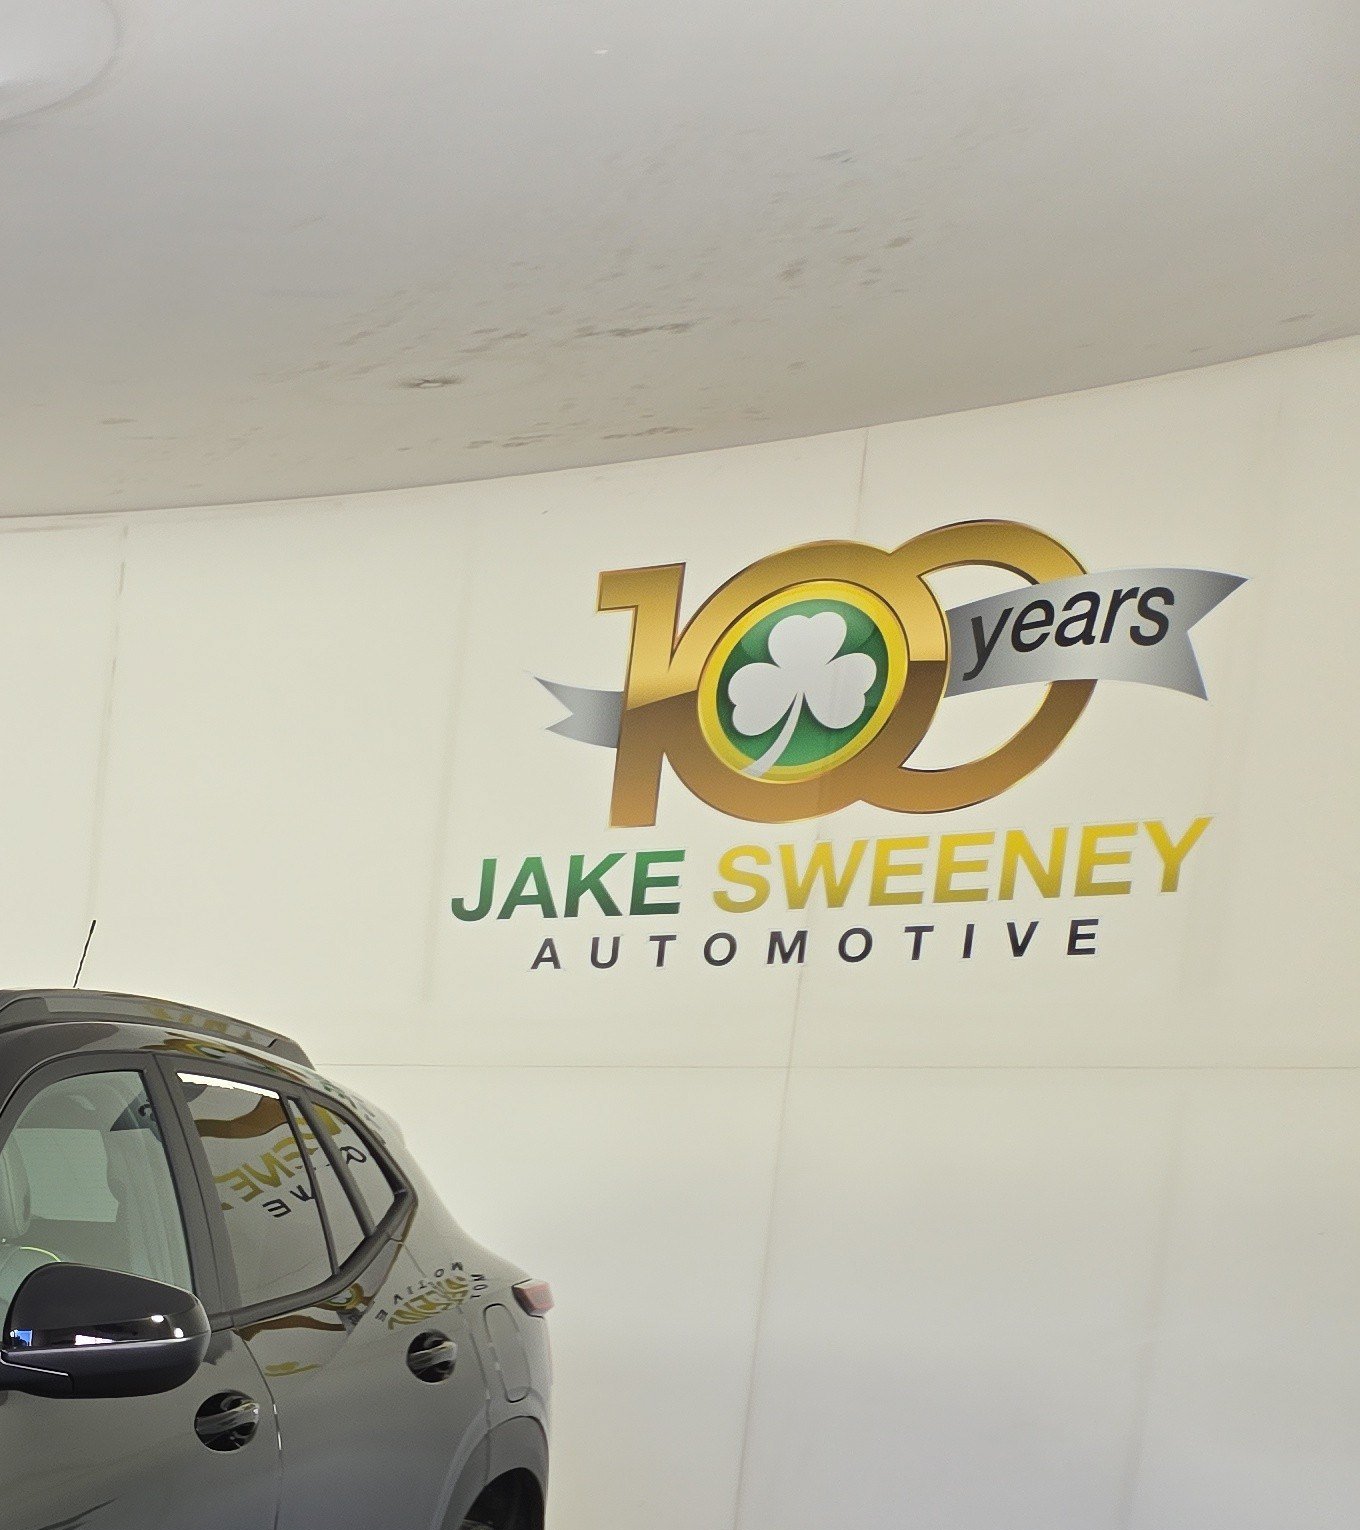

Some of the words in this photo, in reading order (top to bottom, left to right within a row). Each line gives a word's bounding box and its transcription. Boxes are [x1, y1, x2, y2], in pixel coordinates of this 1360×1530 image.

[595, 519, 1098, 828] 100
[963, 586, 1174, 681] years
[451, 848, 686, 922] JAKE
[714, 816, 1214, 914] SWEENEY
[531, 919, 1100, 970] AUTOMOTIVE
